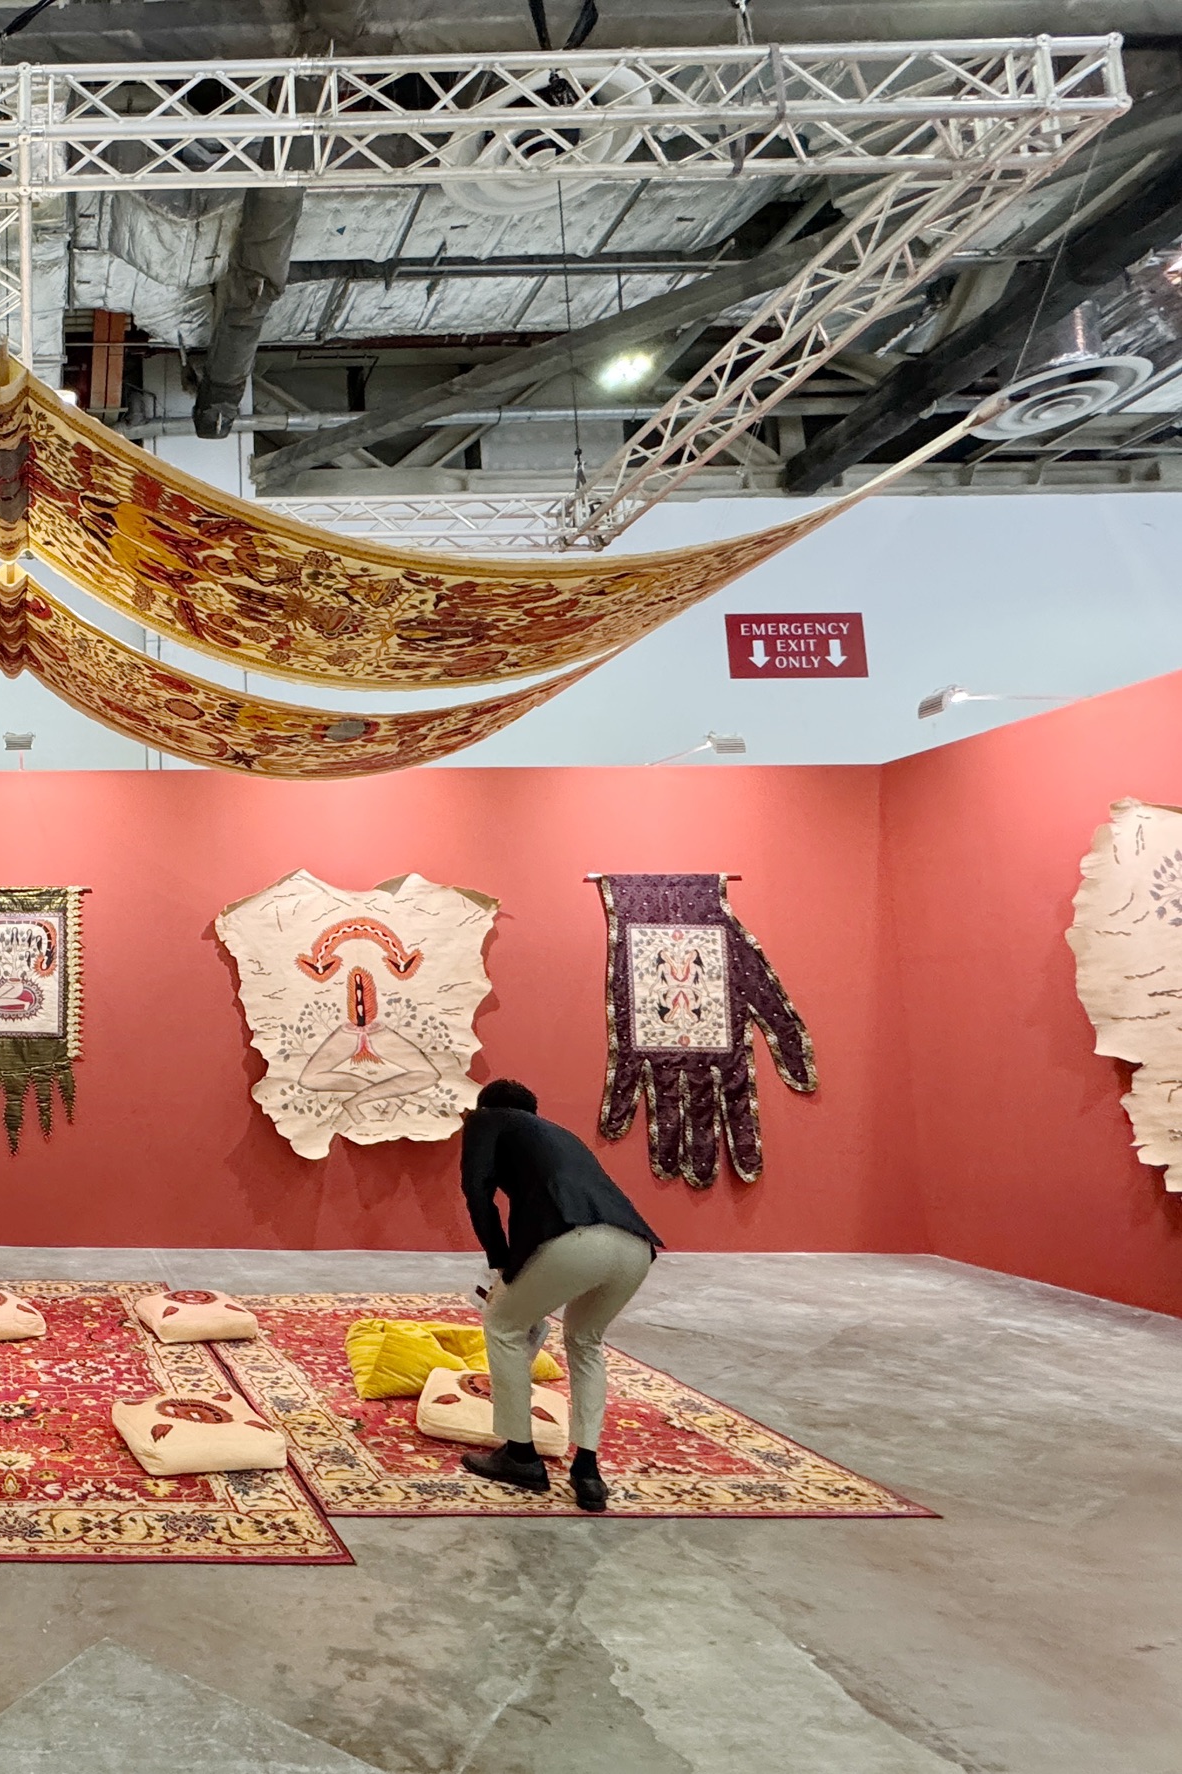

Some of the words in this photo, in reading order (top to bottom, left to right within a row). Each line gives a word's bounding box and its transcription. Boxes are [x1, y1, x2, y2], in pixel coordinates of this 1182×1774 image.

[740, 622, 850, 636] EMERGENCY
[776, 639, 817, 652] EXIT
[775, 655, 821, 669] ONLY
